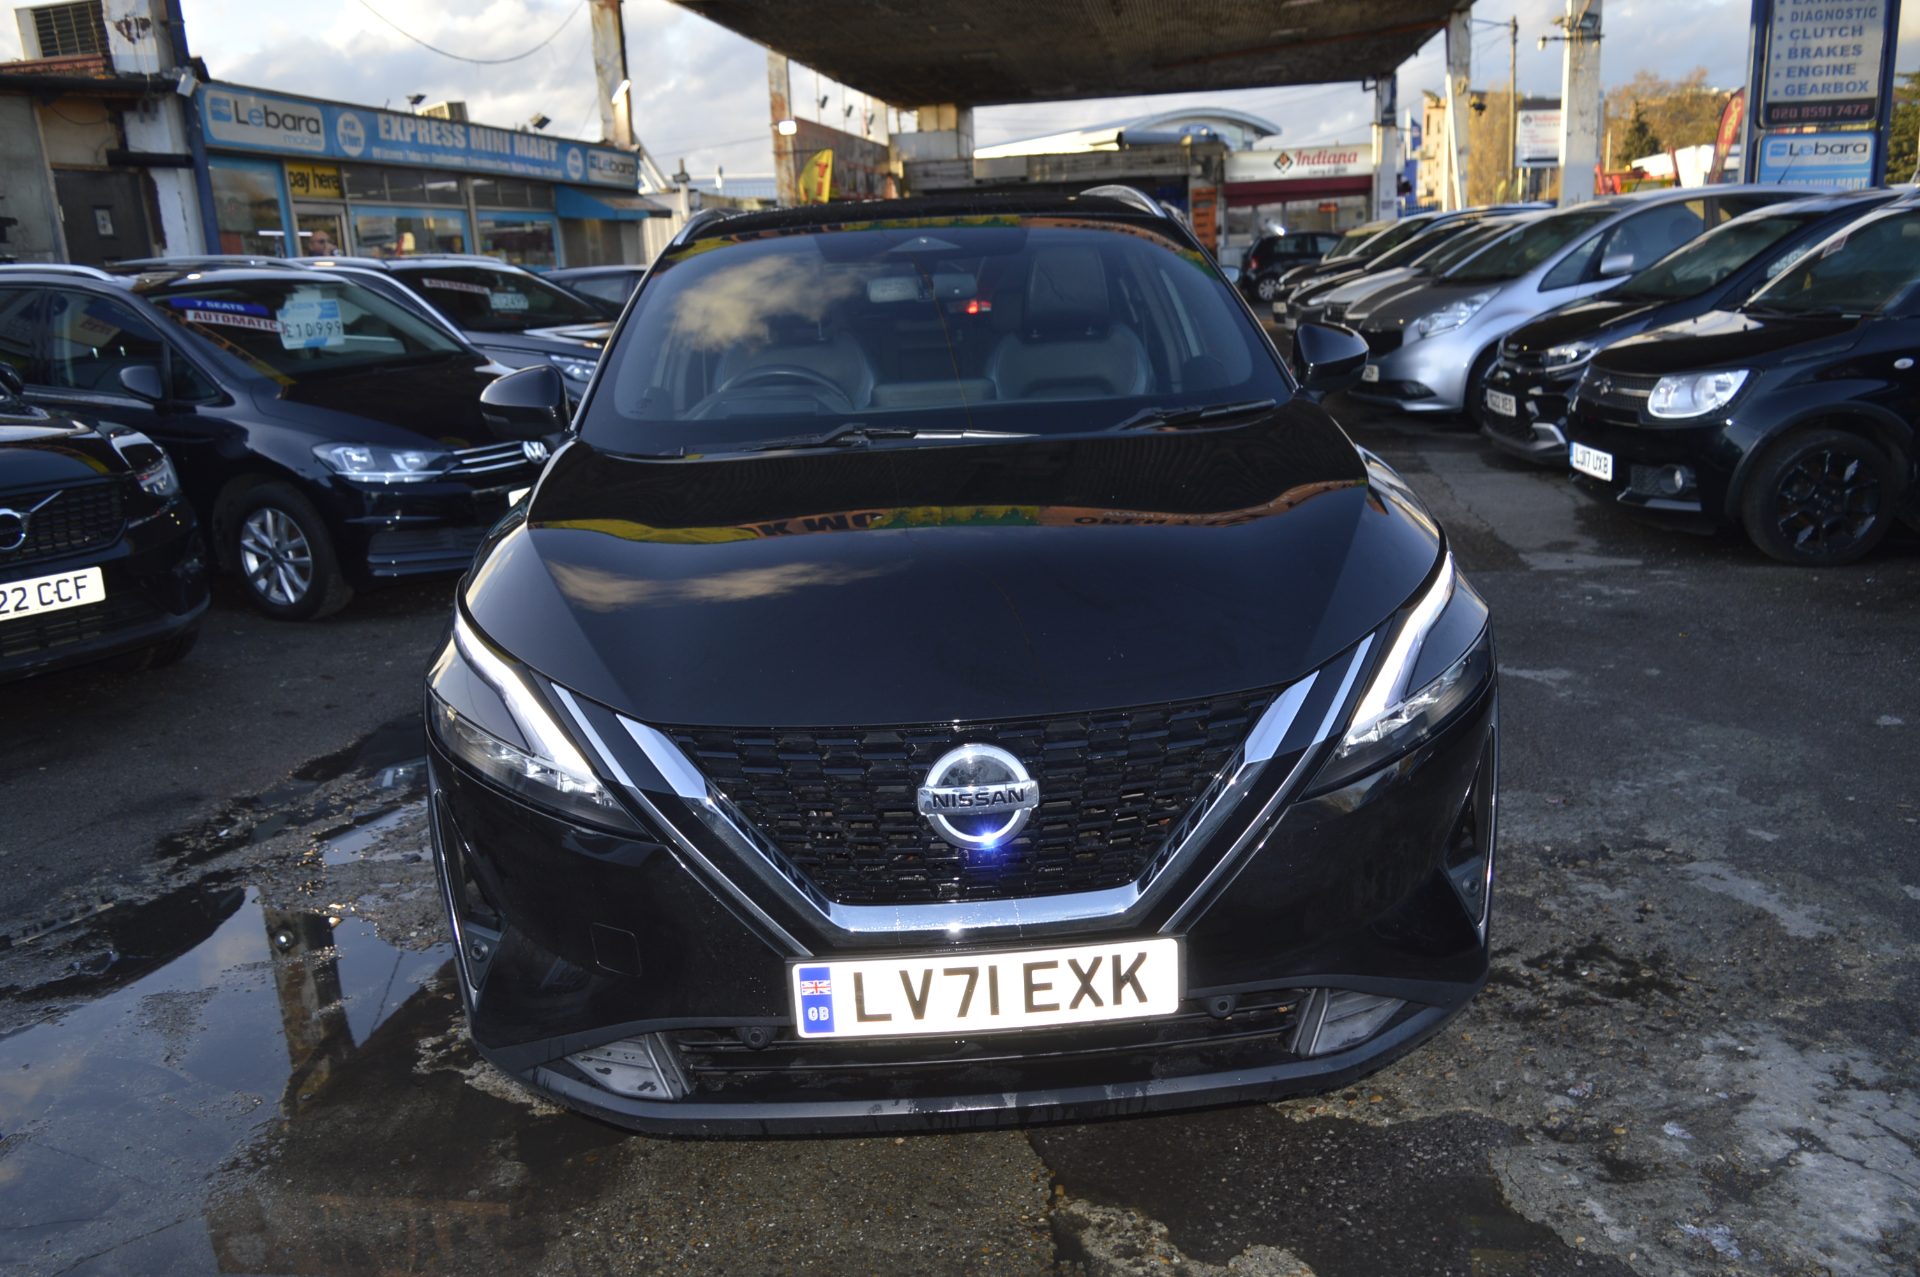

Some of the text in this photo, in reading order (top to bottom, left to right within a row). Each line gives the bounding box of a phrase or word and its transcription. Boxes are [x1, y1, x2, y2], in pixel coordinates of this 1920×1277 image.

[1790, 7, 1878, 22] DIAGNOSTIC
[1789, 25, 1864, 40] CLUTCH
[1787, 44, 1863, 60] BRAKES
[1786, 63, 1857, 79] ENGINE
[1784, 80, 1869, 97] GEARBOX
[233, 98, 321, 135] Lebara
[377, 112, 467, 149] EXPRESS
[469, 125, 511, 155] MINI
[513, 131, 559, 162] MART
[1293, 148, 1359, 167] Indiana
[1788, 140, 1869, 157] Lebara
[288, 167, 340, 194] pay here
[193, 309, 278, 330] AUTOMATIC
[0, 574, 88, 615] 22 CCF
[931, 787, 1025, 808] NISSAN
[853, 951, 1149, 1023] LV71 EXK
[807, 1006, 830, 1022] GB
